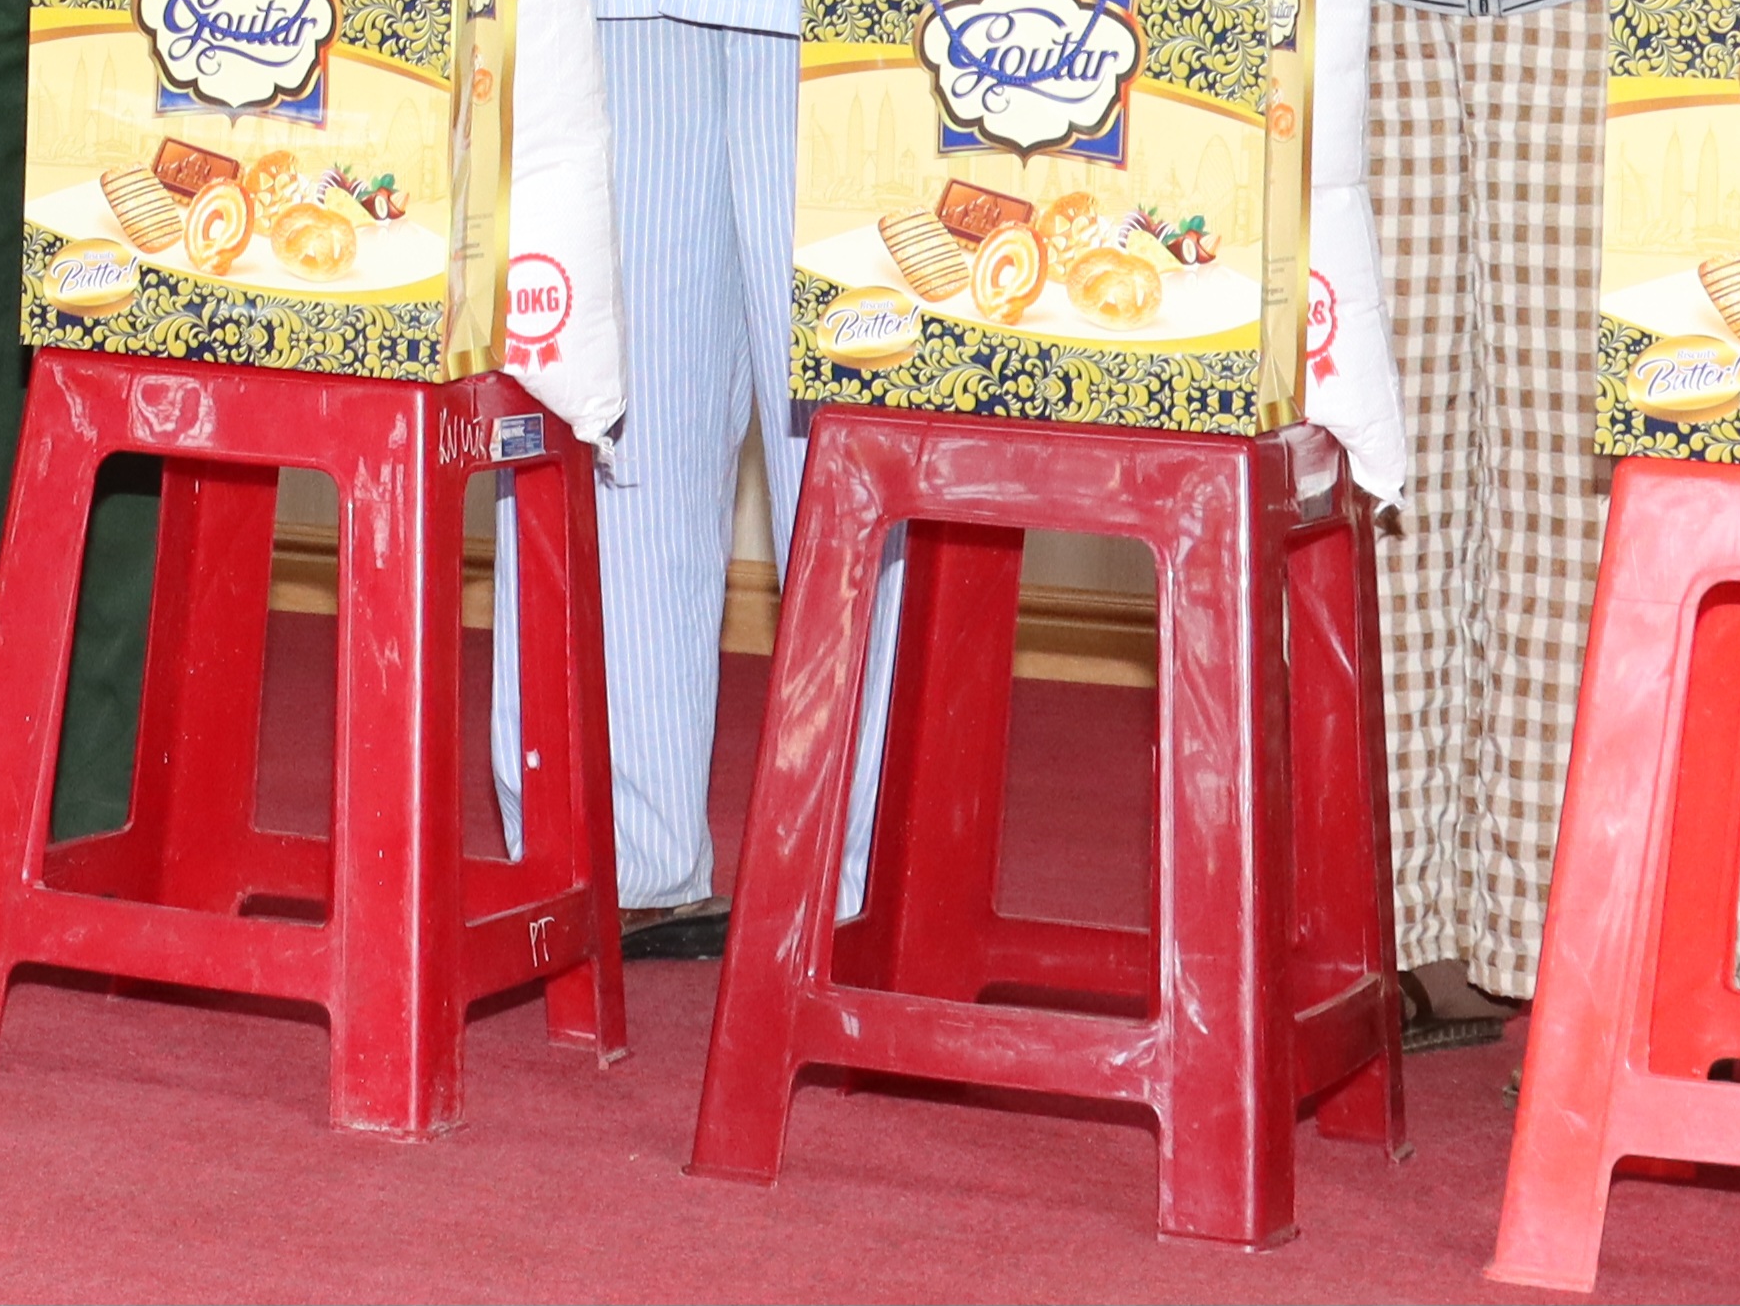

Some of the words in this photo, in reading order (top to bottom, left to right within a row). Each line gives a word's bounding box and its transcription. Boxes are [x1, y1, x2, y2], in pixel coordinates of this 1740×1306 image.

[949, 10, 1119, 113] Goutar
[48, 256, 137, 297] Butter!
[824, 300, 922, 346] Butter!
